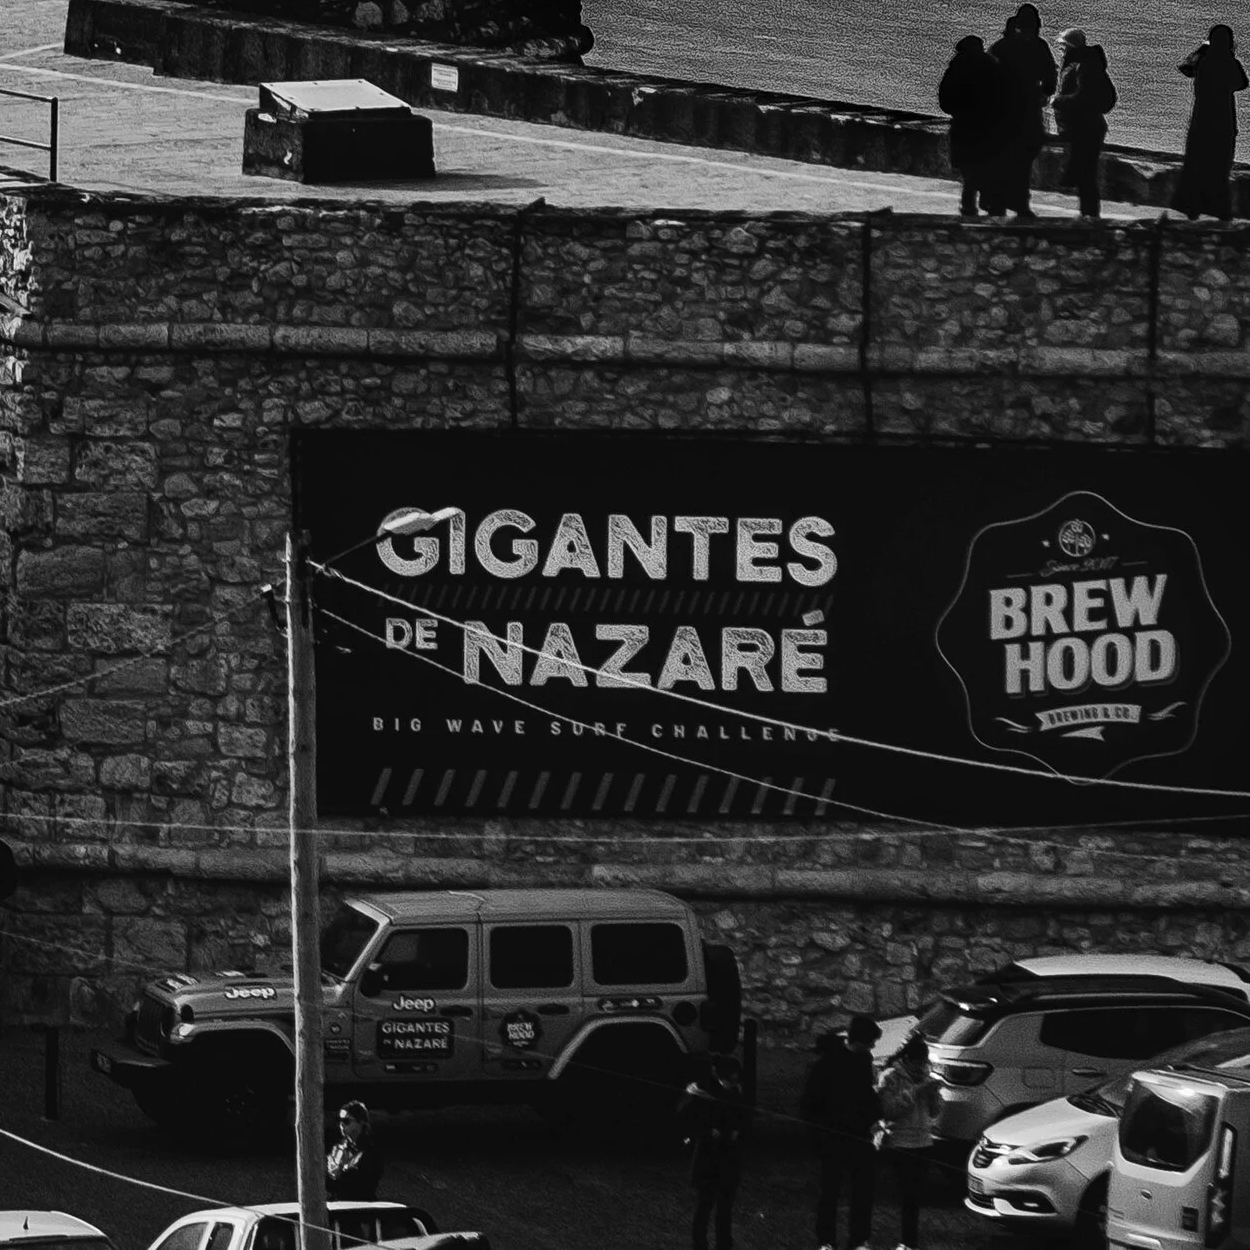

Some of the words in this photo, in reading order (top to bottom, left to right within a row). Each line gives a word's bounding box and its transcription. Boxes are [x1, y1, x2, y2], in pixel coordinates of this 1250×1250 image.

[376, 506, 838, 587] GIGANTES
[989, 573, 1168, 640] BREW
[385, 617, 438, 650] DE
[464, 609, 828, 693] NAZARÉ
[1004, 630, 1178, 696] HOOD
[372, 717, 421, 732] BIG
[446, 719, 525, 735] WAVE
[551, 721, 626, 737] SURF
[225, 988, 276, 999] Jeep
[393, 995, 435, 1013] Jeep
[382, 1021, 450, 1034] GIGANTES
[394, 1036, 449, 1049] NAZARÉ
